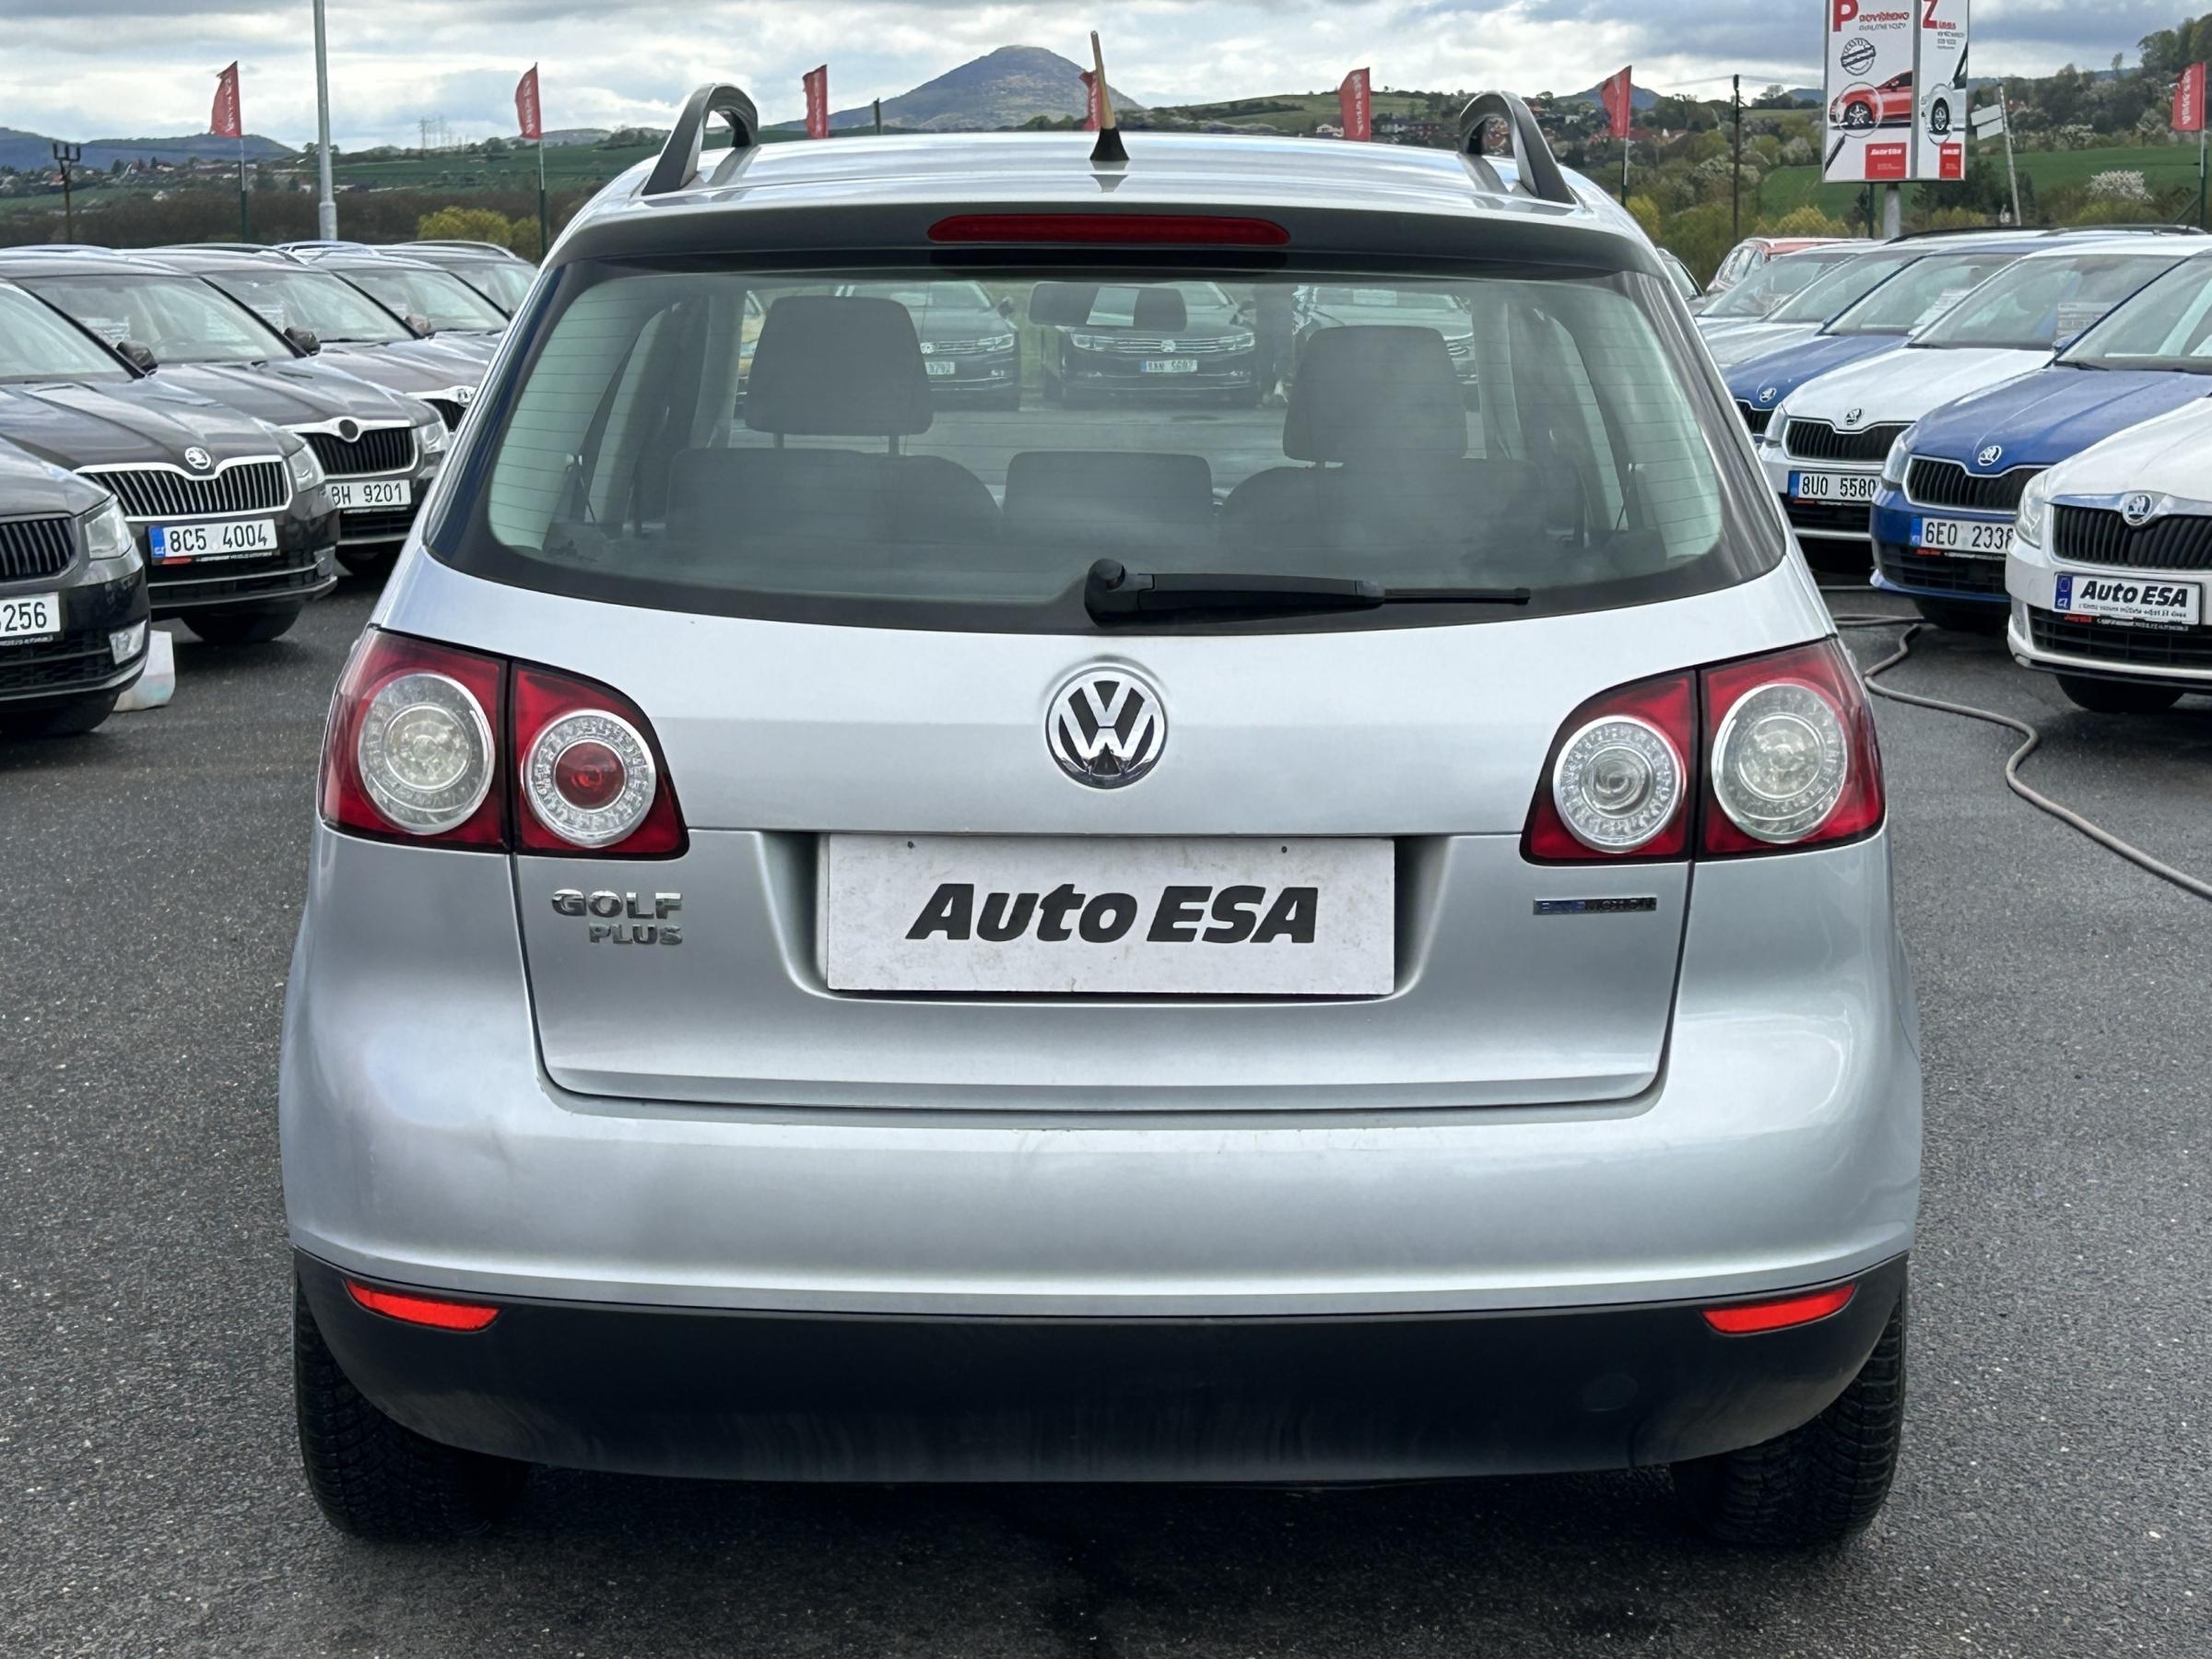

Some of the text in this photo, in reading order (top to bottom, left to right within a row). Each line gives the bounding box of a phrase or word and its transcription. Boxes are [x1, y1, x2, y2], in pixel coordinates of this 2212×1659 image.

[363, 482, 402, 503] 9201
[1840, 477, 1876, 499] 5580
[170, 527, 206, 553] 8C5
[222, 524, 267, 548] 4004
[2080, 581, 2138, 604] Auto
[2140, 585, 2188, 607] ESA
[0, 601, 47, 632] 256
[551, 888, 682, 920] GOLF
[905, 883, 1319, 943] Auto ESA
[589, 922, 683, 946] PLUS
